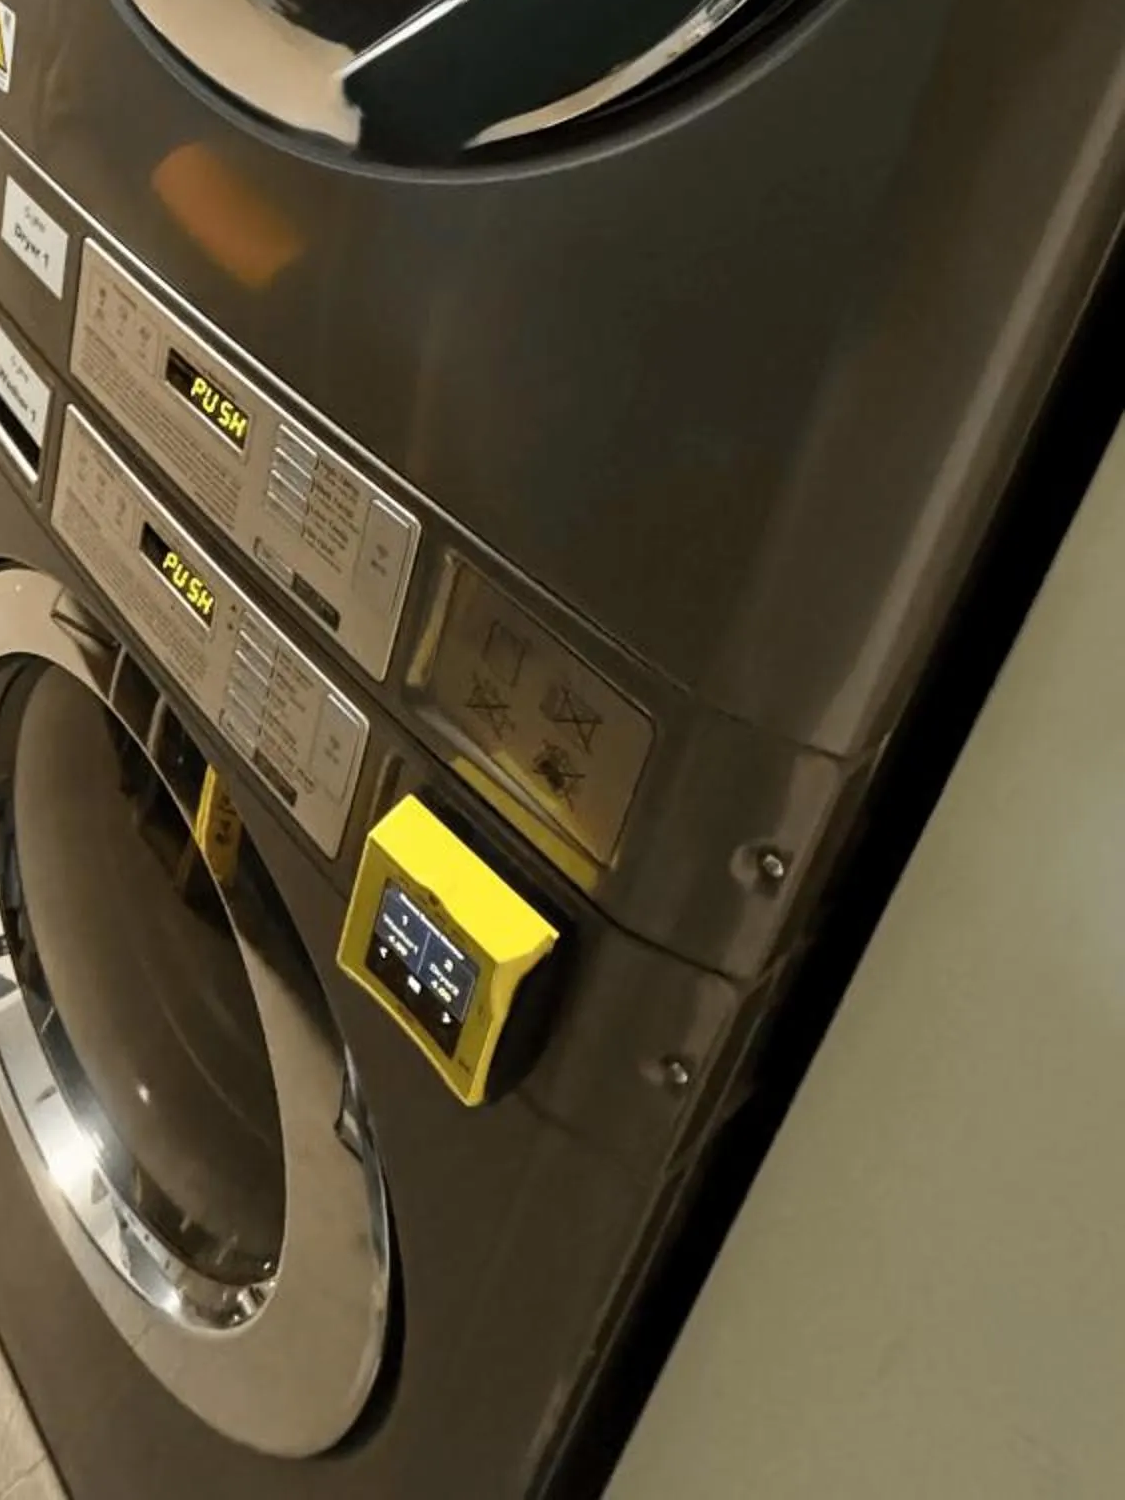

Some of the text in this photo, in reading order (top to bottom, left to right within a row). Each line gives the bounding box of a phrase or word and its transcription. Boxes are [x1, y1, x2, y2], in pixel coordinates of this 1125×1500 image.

[14, 222, 41, 258] Dryer
[190, 376, 249, 438] PUSH
[162, 551, 215, 616] PUSH
